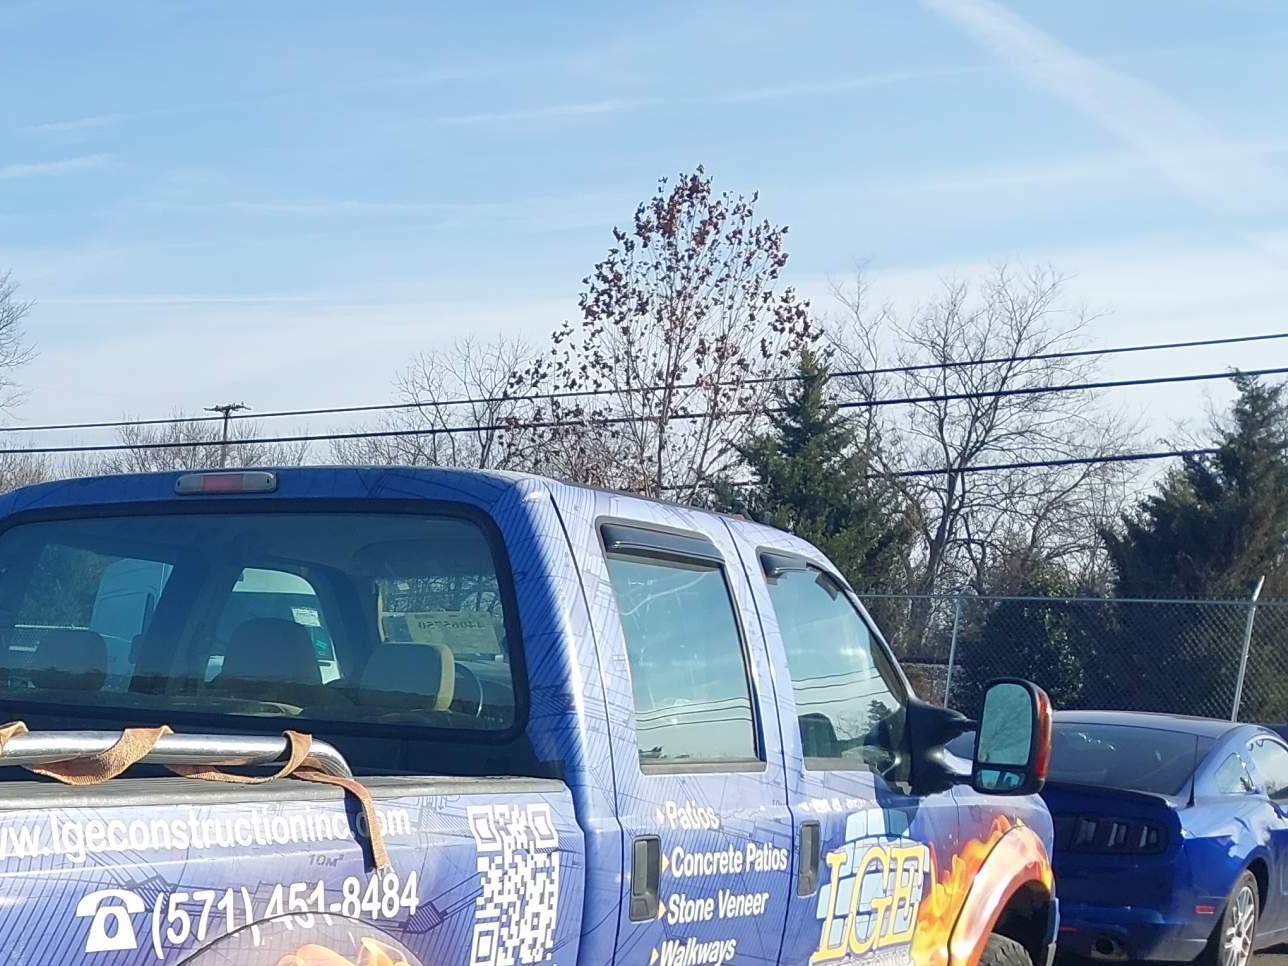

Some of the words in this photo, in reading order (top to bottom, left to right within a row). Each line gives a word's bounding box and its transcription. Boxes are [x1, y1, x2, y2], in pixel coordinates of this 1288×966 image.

[665, 800, 721, 831] Patios
[671, 844, 743, 878] Concrete
[745, 841, 788, 872] Patios
[152, 886, 262, 960] (571)
[263, 870, 420, 931] 451-8484
[667, 893, 715, 925] Stone
[718, 889, 769, 919] Veneer
[812, 845, 924, 963] LGE
